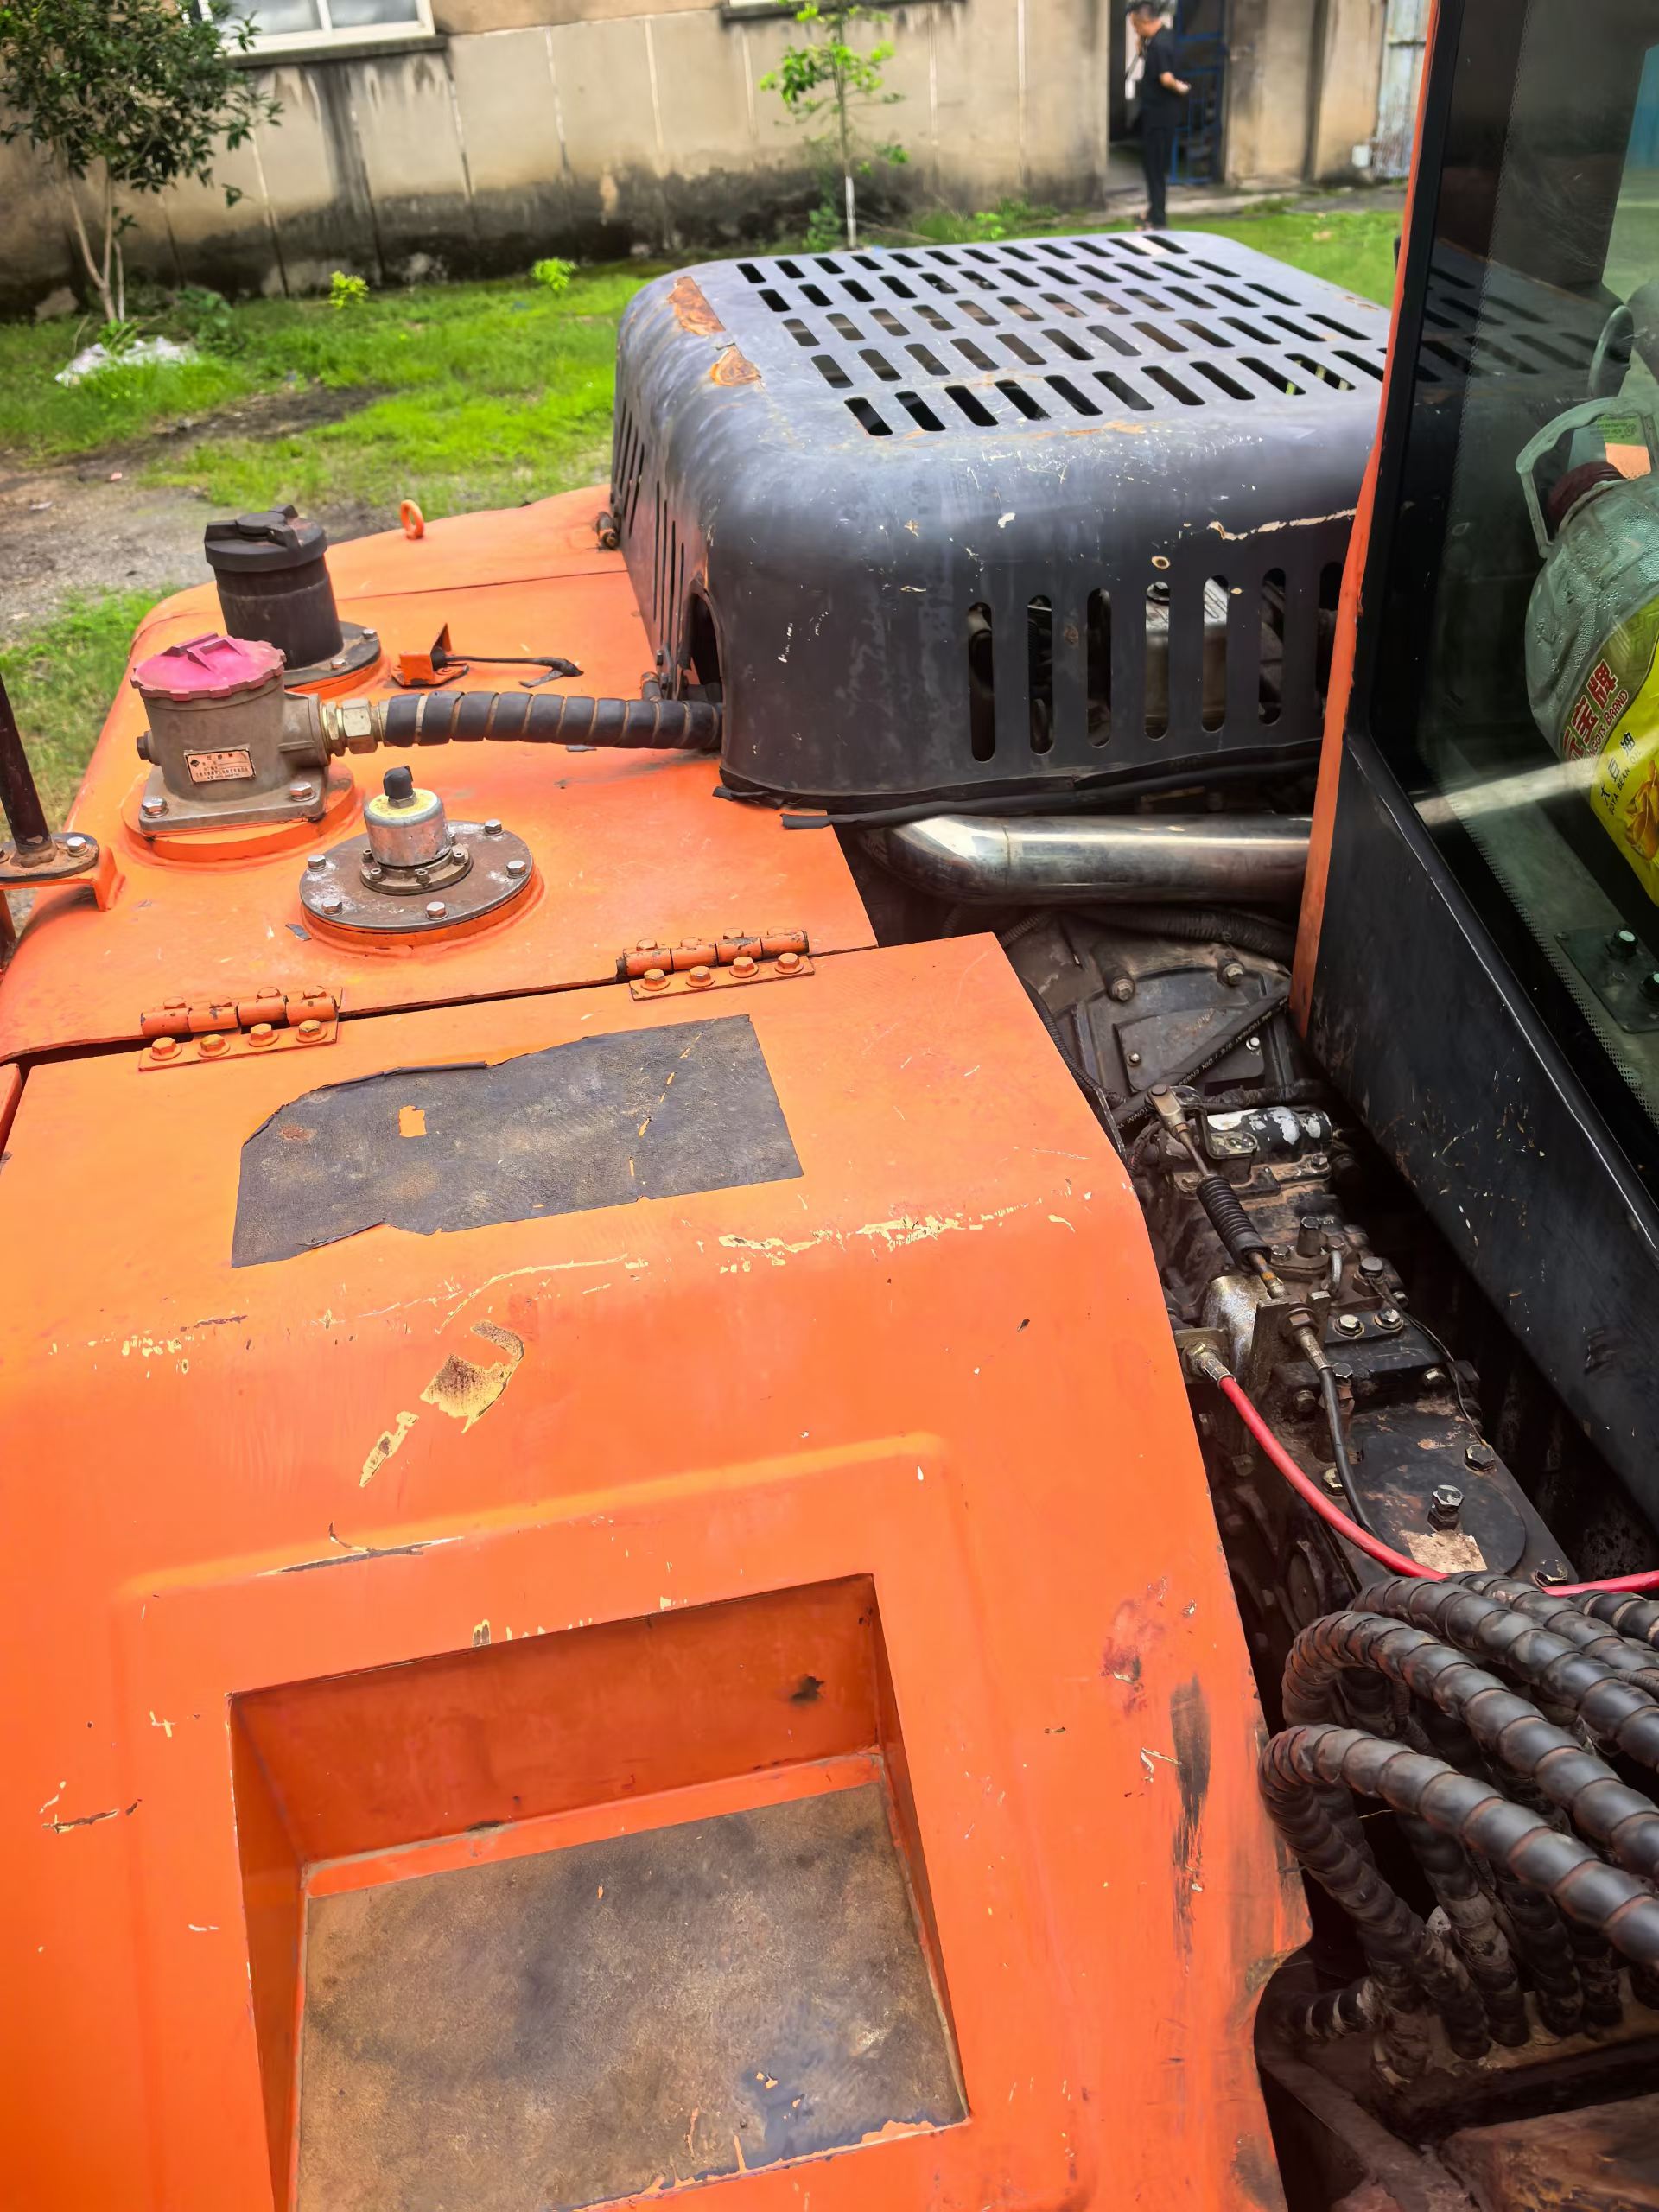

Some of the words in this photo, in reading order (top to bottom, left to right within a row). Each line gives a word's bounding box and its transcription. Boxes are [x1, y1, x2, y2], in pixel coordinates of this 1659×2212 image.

[1562, 659, 1618, 761] 元宝牌
[1604, 690, 1629, 727] BRAND
[1601, 733, 1635, 806] 大豆油
[1609, 793, 1619, 816] SOYA
[1617, 766, 1630, 791] BEAN
[1630, 748, 1641, 764] OIL
